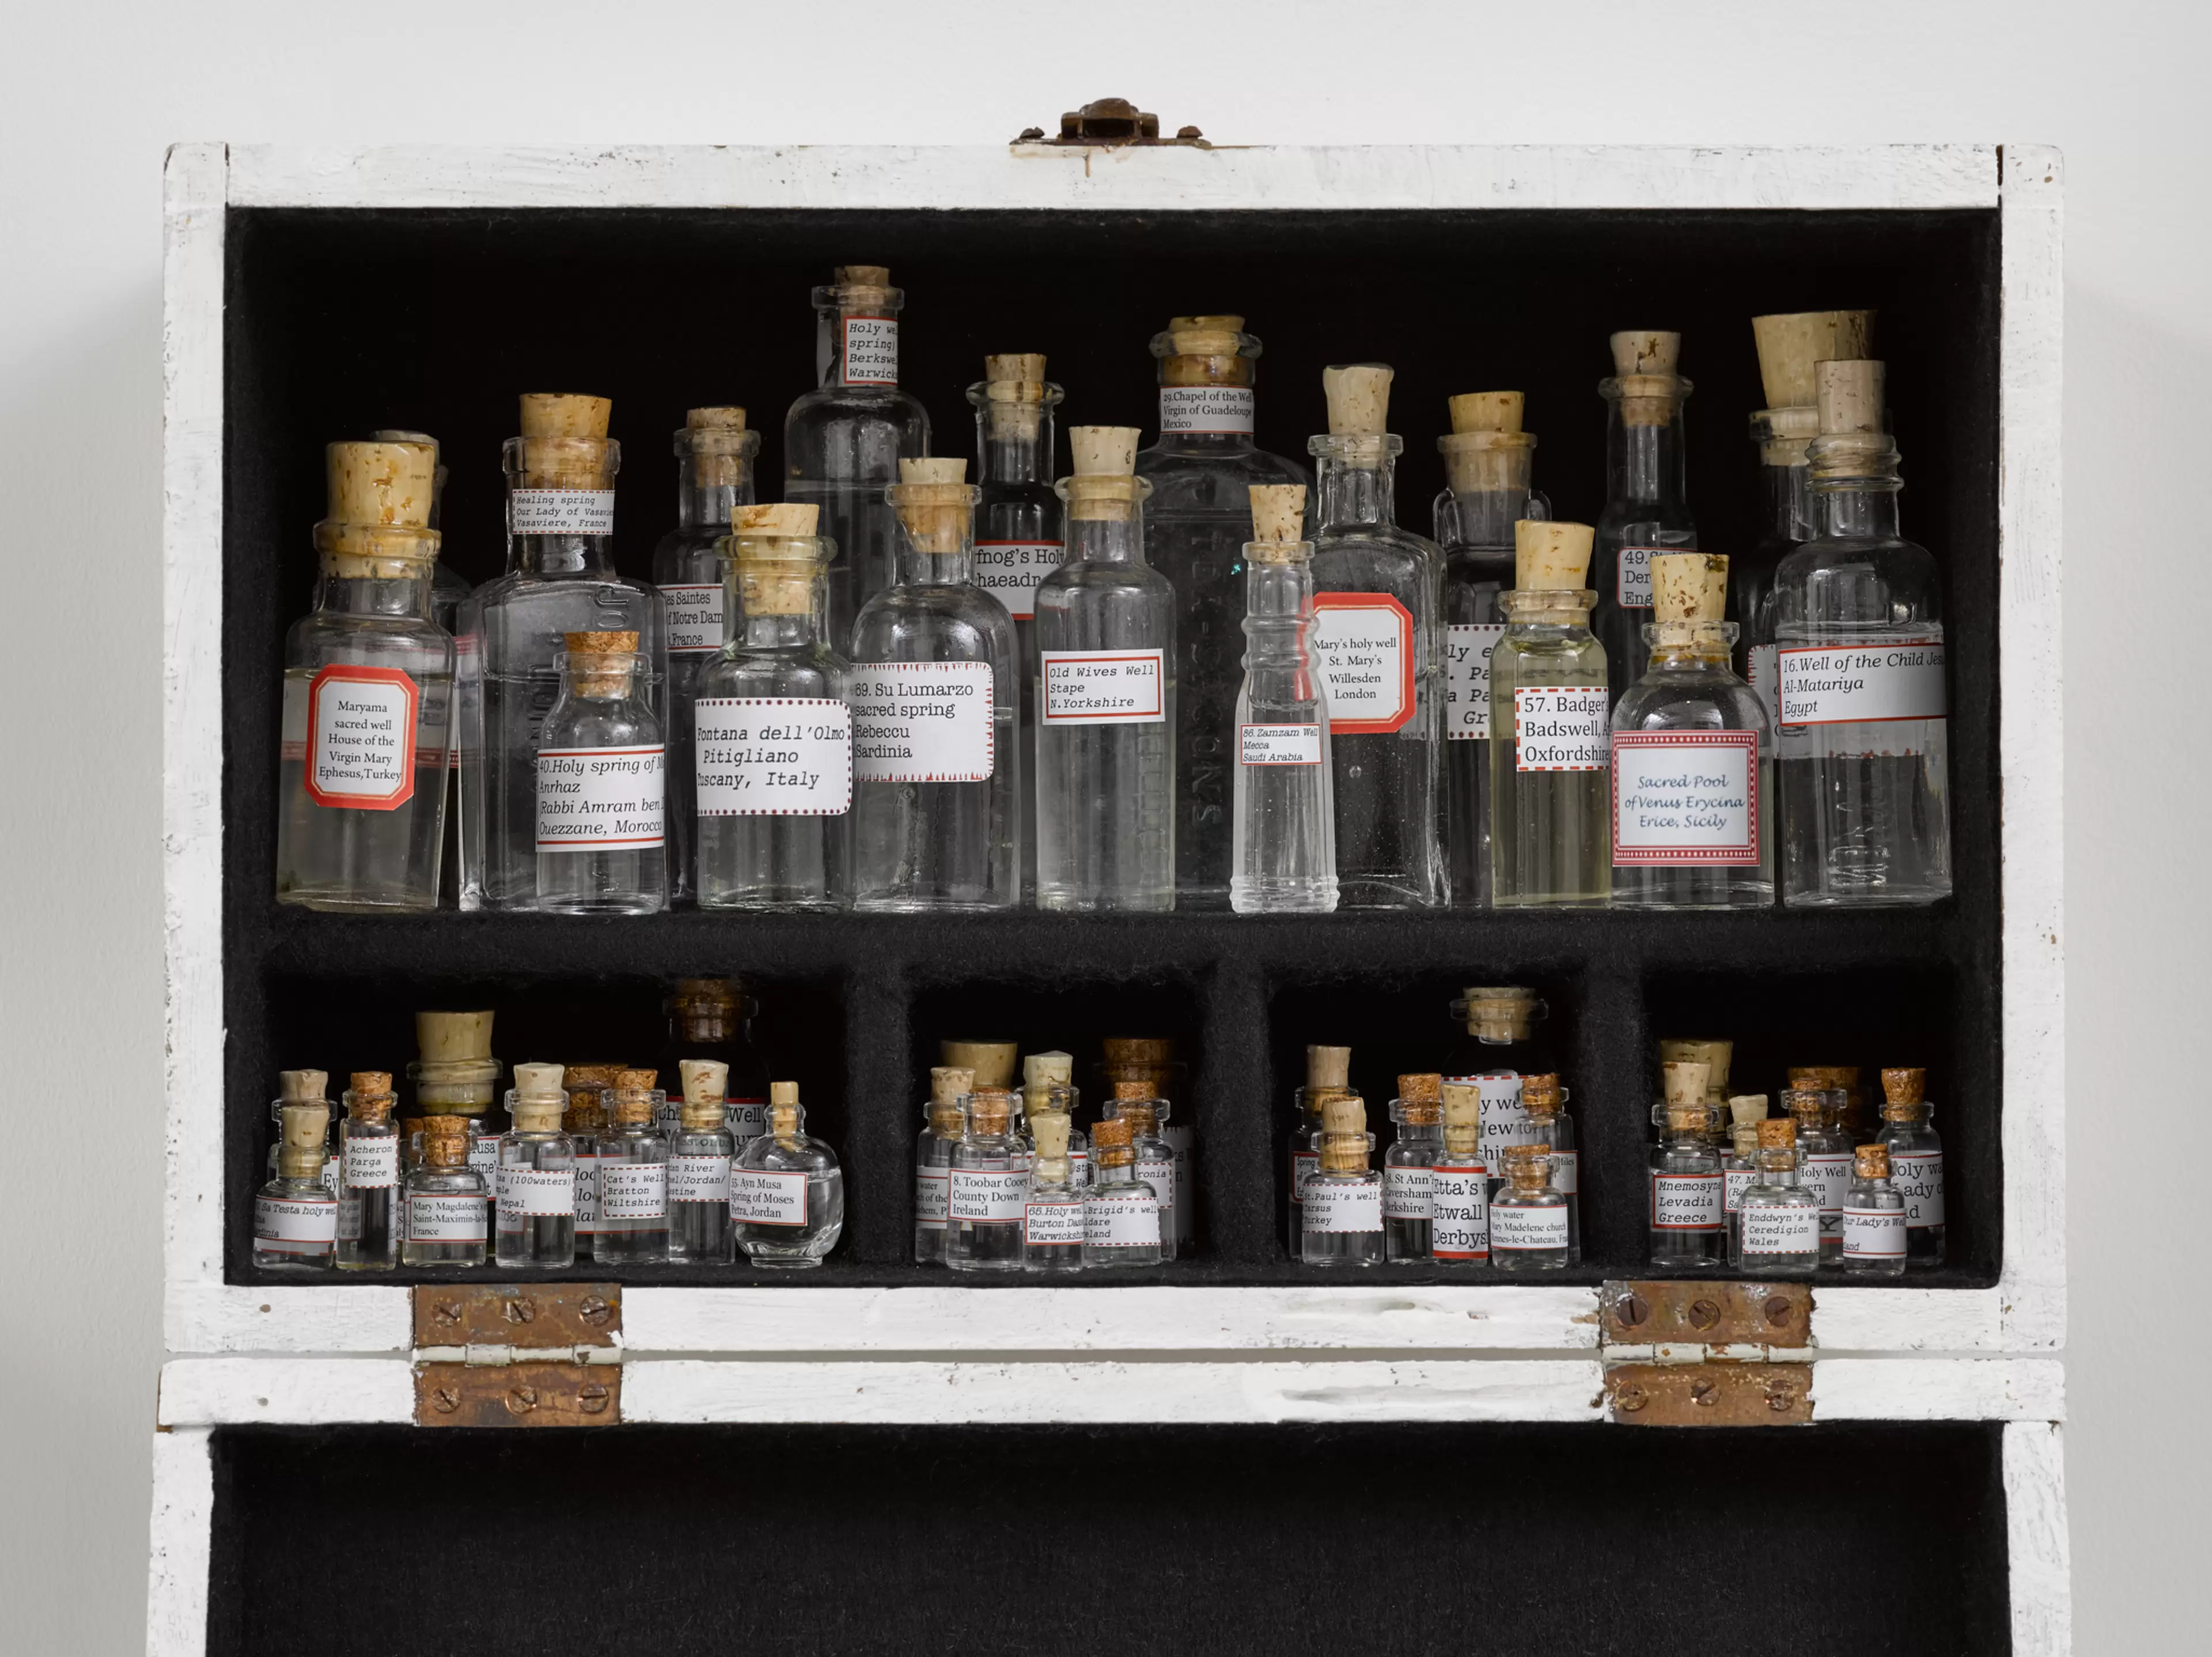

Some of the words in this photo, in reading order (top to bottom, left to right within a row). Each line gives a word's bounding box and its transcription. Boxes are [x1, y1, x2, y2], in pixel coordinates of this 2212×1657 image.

[849, 324, 881, 335] Holy
[850, 339, 895, 351] spring)
[1210, 391, 1220, 400] of
[1222, 391, 1237, 401] the
[1164, 405, 1186, 417] Virgin
[1190, 405, 1200, 415] of
[1164, 419, 1191, 429] Mexico
[517, 496, 554, 505] Healing
[560, 496, 595, 506] spring
[536, 508, 560, 517] Lady
[975, 548, 1029, 567] fnog's
[1625, 551, 1647, 564] 49.
[977, 572, 1041, 587] haeadr
[676, 592, 710, 605] Saintes
[1624, 592, 1653, 607] Eng
[673, 612, 698, 624] Notre
[700, 611, 722, 624] Dam
[1350, 638, 1373, 650] holy
[1376, 638, 1396, 647] well
[1329, 656, 1342, 666] St.
[1347, 654, 1382, 668] Mary's
[1835, 655, 1853, 673] of
[1855, 654, 1881, 668] the
[1887, 652, 1925, 667] Child
[1050, 668, 1069, 678] Old
[1077, 666, 1117, 677] Wives
[1126, 665, 1154, 675] Well
[1329, 673, 1381, 683] Willesden
[876, 682, 893, 696] Su
[897, 683, 973, 696] Lumarzo
[1051, 684, 1085, 695] Stape
[1784, 678, 1863, 694] Al-Matariya
[1335, 689, 1376, 699] London
[338, 700, 387, 714] Maryama
[856, 703, 896, 716] sacred
[900, 703, 955, 719] spring
[1525, 697, 1550, 712] 57.
[1556, 696, 1608, 716] Badger'
[1785, 701, 1818, 718] Egypt
[335, 719, 368, 729] sacred
[371, 720, 391, 730] well
[1525, 721, 1601, 738] Badswell,
[698, 728, 747, 740] Fontana
[856, 725, 910, 738] Rebeccu
[1304, 728, 1317, 736] Well
[328, 733, 362, 745] House
[365, 735, 377, 745] of
[378, 735, 395, 746] the
[1244, 741, 1269, 749] Mecca
[855, 744, 912, 758] Sardinia
[1243, 753, 1266, 761] Saudi
[329, 751, 361, 765] Virgin
[364, 753, 392, 766] Mary
[703, 748, 798, 767] Pitigliano
[590, 759, 639, 775] spring
[644, 756, 656, 773] of
[540, 780, 580, 793] Anrhaz
[766, 772, 819, 789] Italy
[1638, 775, 1691, 789] Sacred
[1694, 775, 1728, 788] Pool
[578, 801, 637, 813] Amram
[642, 798, 660, 811] ben
[1686, 796, 1744, 811] Erycina
[540, 821, 607, 836] Ouezzane,
[614, 820, 662, 833] Morocco
[1640, 815, 1679, 828] Erice,
[1684, 814, 1727, 831] Sicily
[729, 1108, 760, 1122] Well
[350, 1158, 381, 1167] Parga
[684, 1165, 715, 1173] River
[1825, 1166, 1846, 1177] Well
[644, 1174, 664, 1182] Well
[740, 1178, 755, 1189] Ayn
[757, 1178, 782, 1189] Musa
[953, 1176, 961, 1186] 8.
[963, 1177, 1002, 1188] Toobar
[1395, 1174, 1403, 1184] St
[1407, 1175, 1433, 1184] Ann'
[731, 1190, 751, 1204] Spring
[753, 1192, 762, 1202] of
[764, 1193, 794, 1204] Moses
[953, 1190, 988, 1204] County
[992, 1192, 1019, 1202] Down
[1357, 1192, 1377, 1200] well
[1659, 1196, 1713, 1207] Levadia
[414, 1202, 433, 1212] Mary
[608, 1199, 660, 1207] Wiltshire
[274, 1204, 300, 1214] Testa
[302, 1206, 323, 1217] holy
[750, 1207, 781, 1218] Jordan
[953, 1204, 988, 1215] Ireland
[1029, 1219, 1064, 1228] Burton
[1659, 1212, 1707, 1223] Greece
[1749, 1214, 1803, 1224] Enddwyn's
[1856, 1218, 1889, 1228] Lady's
[413, 1226, 438, 1235] France
[1505, 1223, 1544, 1231] Madelene
[1749, 1226, 1809, 1235] Ceredigion
